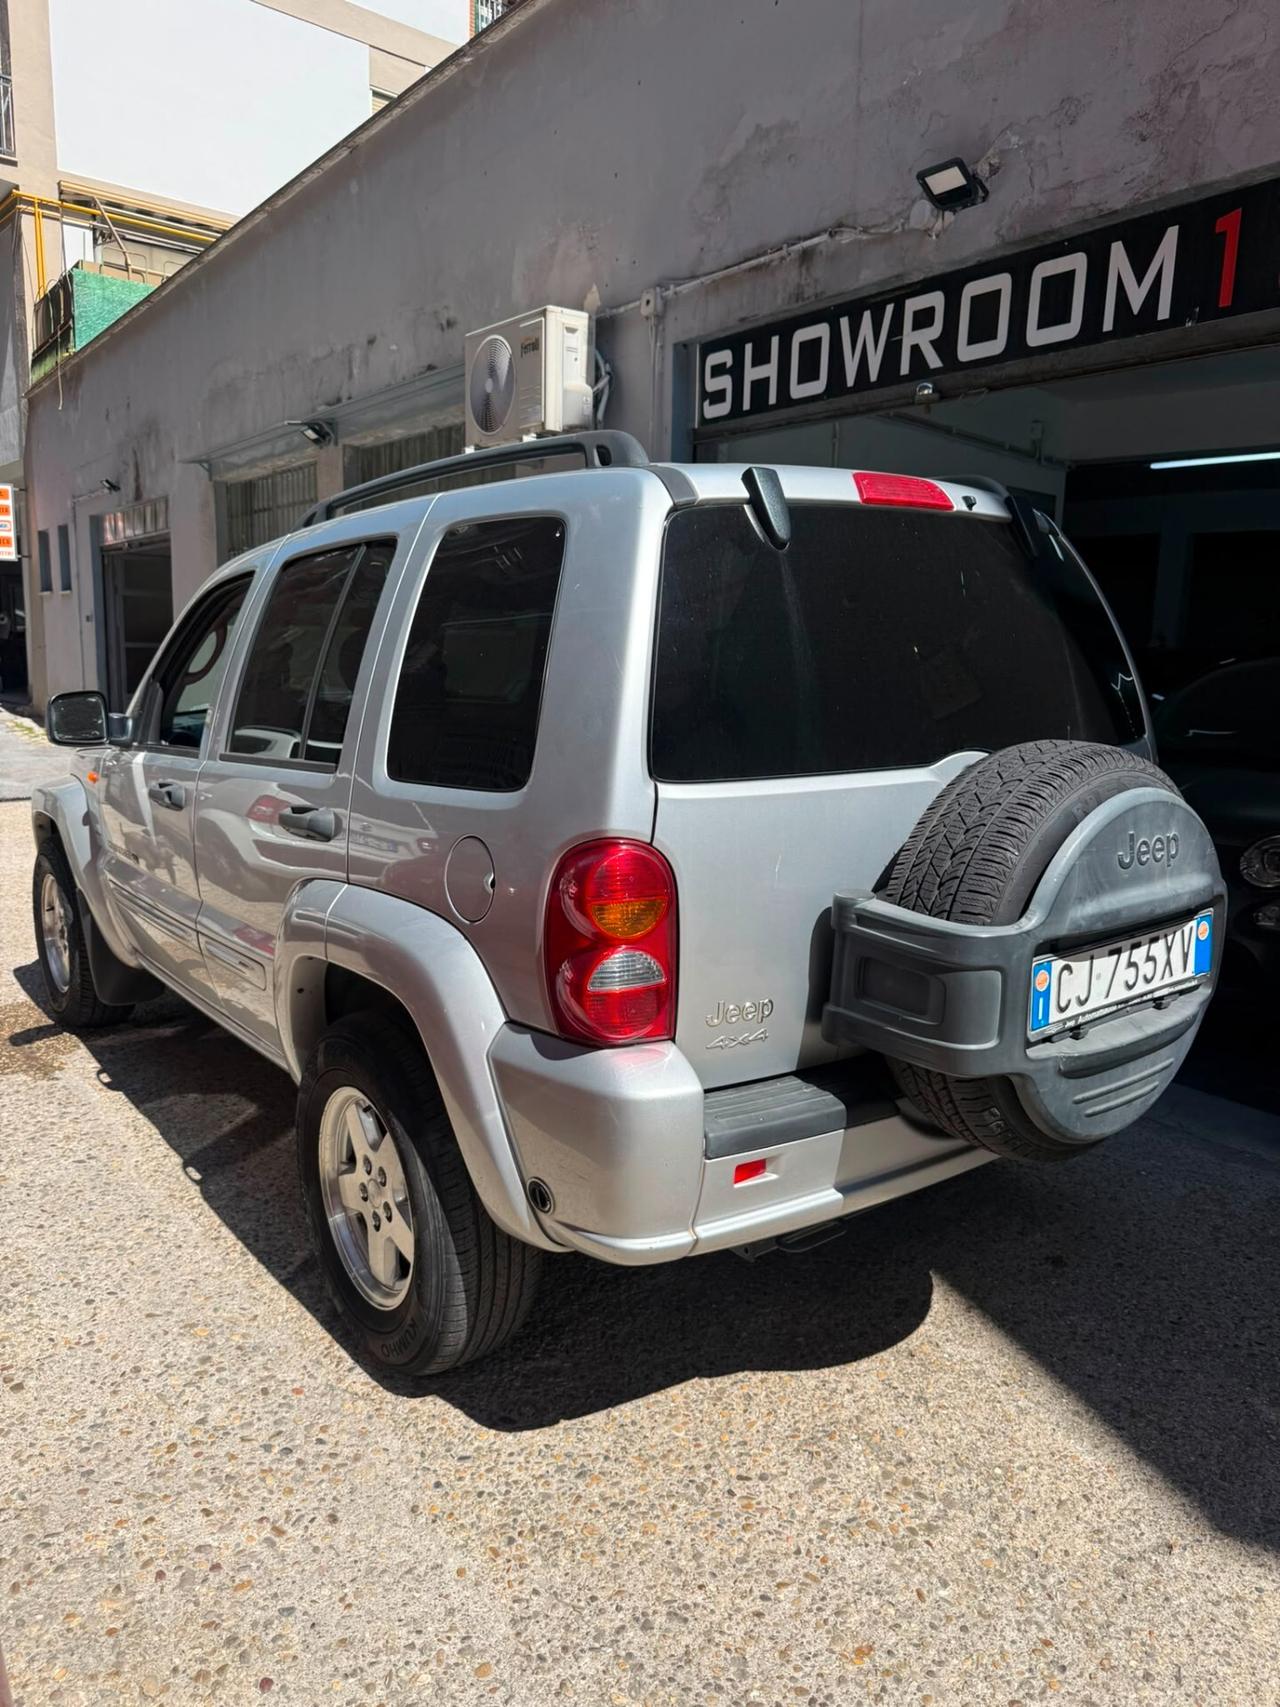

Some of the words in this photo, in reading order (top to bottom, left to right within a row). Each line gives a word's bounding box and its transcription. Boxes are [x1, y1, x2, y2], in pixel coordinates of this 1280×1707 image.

[703, 225, 1180, 419] SHOWROOM
[1215, 207, 1242, 308] 1
[1117, 831, 1180, 870] Jeep
[705, 999, 774, 1028] Jeep
